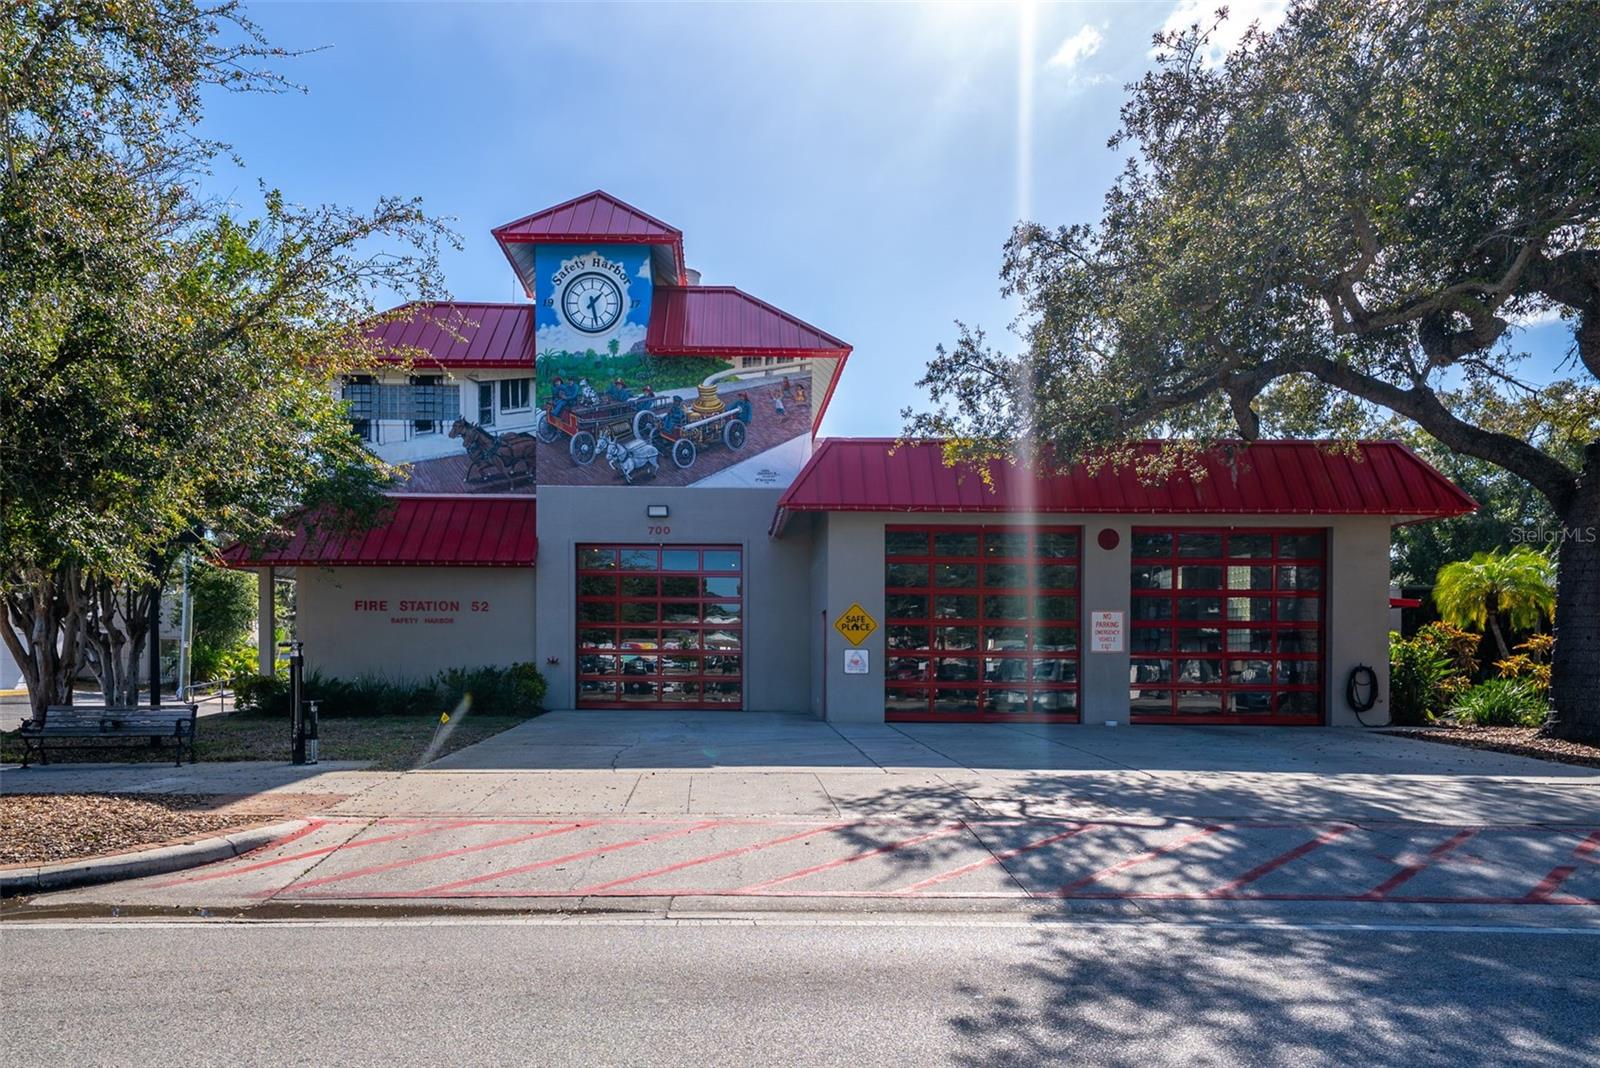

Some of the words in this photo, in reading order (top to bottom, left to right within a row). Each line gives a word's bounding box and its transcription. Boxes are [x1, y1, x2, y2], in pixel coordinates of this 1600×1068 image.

[552, 259, 586, 286] Safety
[592, 258, 632, 286] Harbor
[543, 298, 554, 308] 19
[648, 526, 671, 535] 700
[354, 600, 388, 611] FIRE
[399, 600, 460, 612] STATION
[471, 601, 490, 612] 52
[845, 615, 866, 623] SAFE
